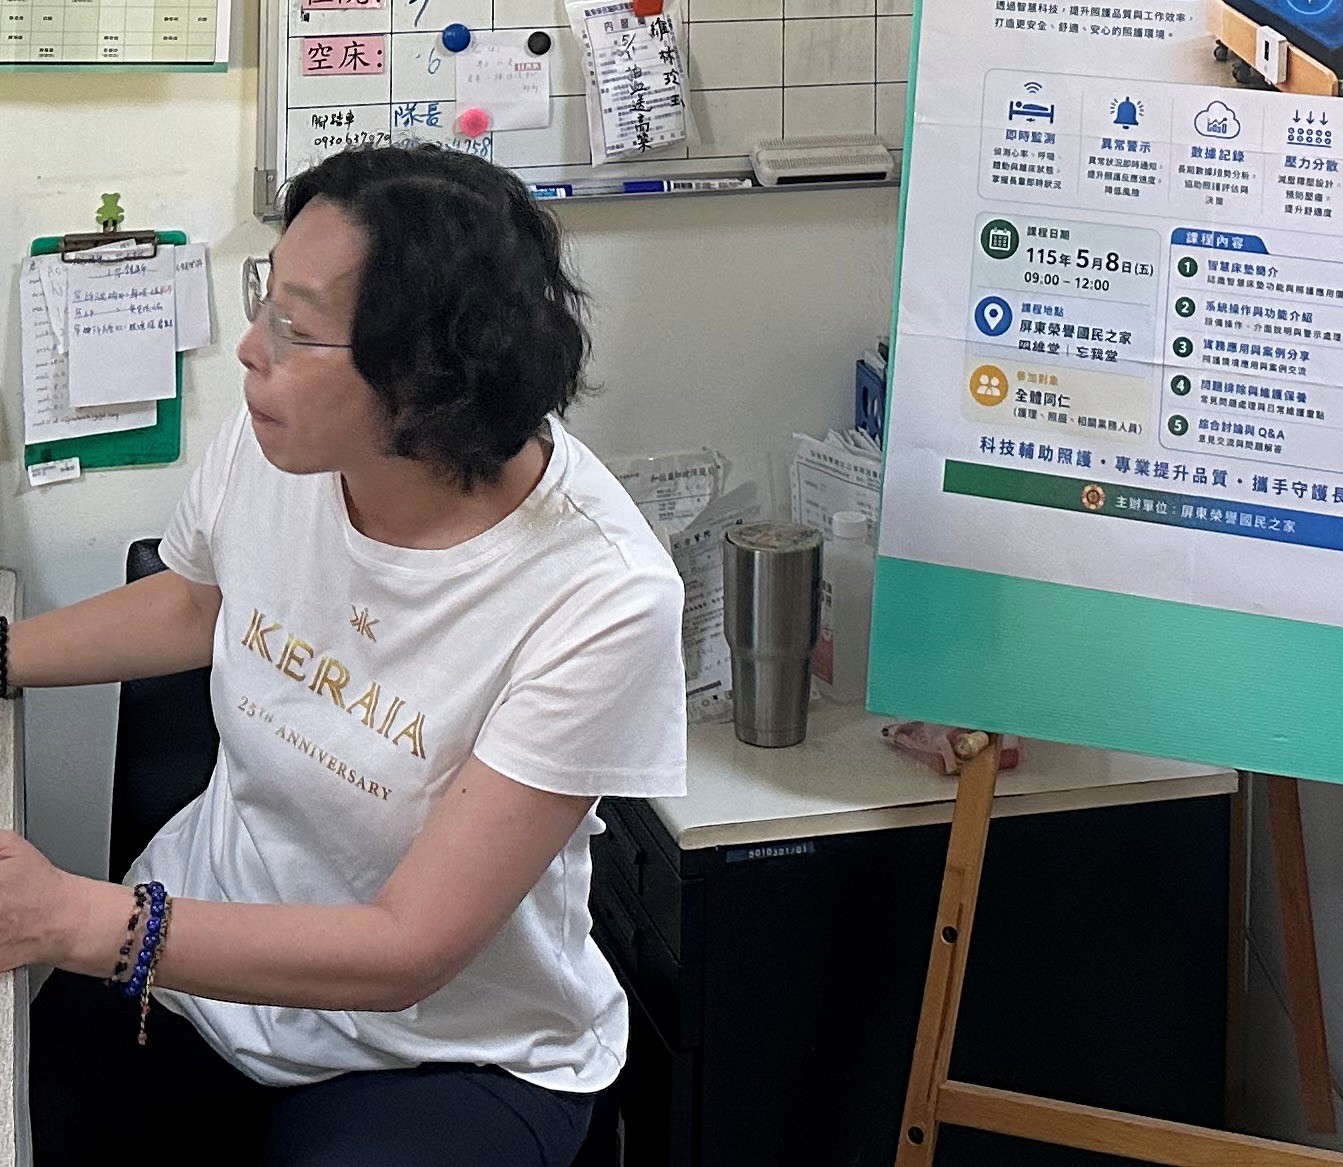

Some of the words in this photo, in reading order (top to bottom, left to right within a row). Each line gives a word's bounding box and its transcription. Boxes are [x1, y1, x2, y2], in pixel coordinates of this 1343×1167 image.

[428, 47, 440, 74] 6
[1006, 129, 1055, 144] 即時監測
[1101, 138, 1151, 153] 異常警示
[1284, 156, 1338, 172] 壓力分散
[1027, 226, 1070, 240] 課程日期
[1027, 247, 1071, 267] 115年
[1024, 272, 1059, 285] 09:00
[1075, 277, 1109, 291] 12:00
[1021, 303, 1064, 317] 課程地點
[1020, 319, 1132, 344] 屏東榮譽國民之家
[1015, 389, 1071, 408] 全體同仁
[1258, 427, 1285, 441] Q&A
[241, 608, 427, 761] KERAIA
[275, 723, 393, 802] ANNIVERSARY
